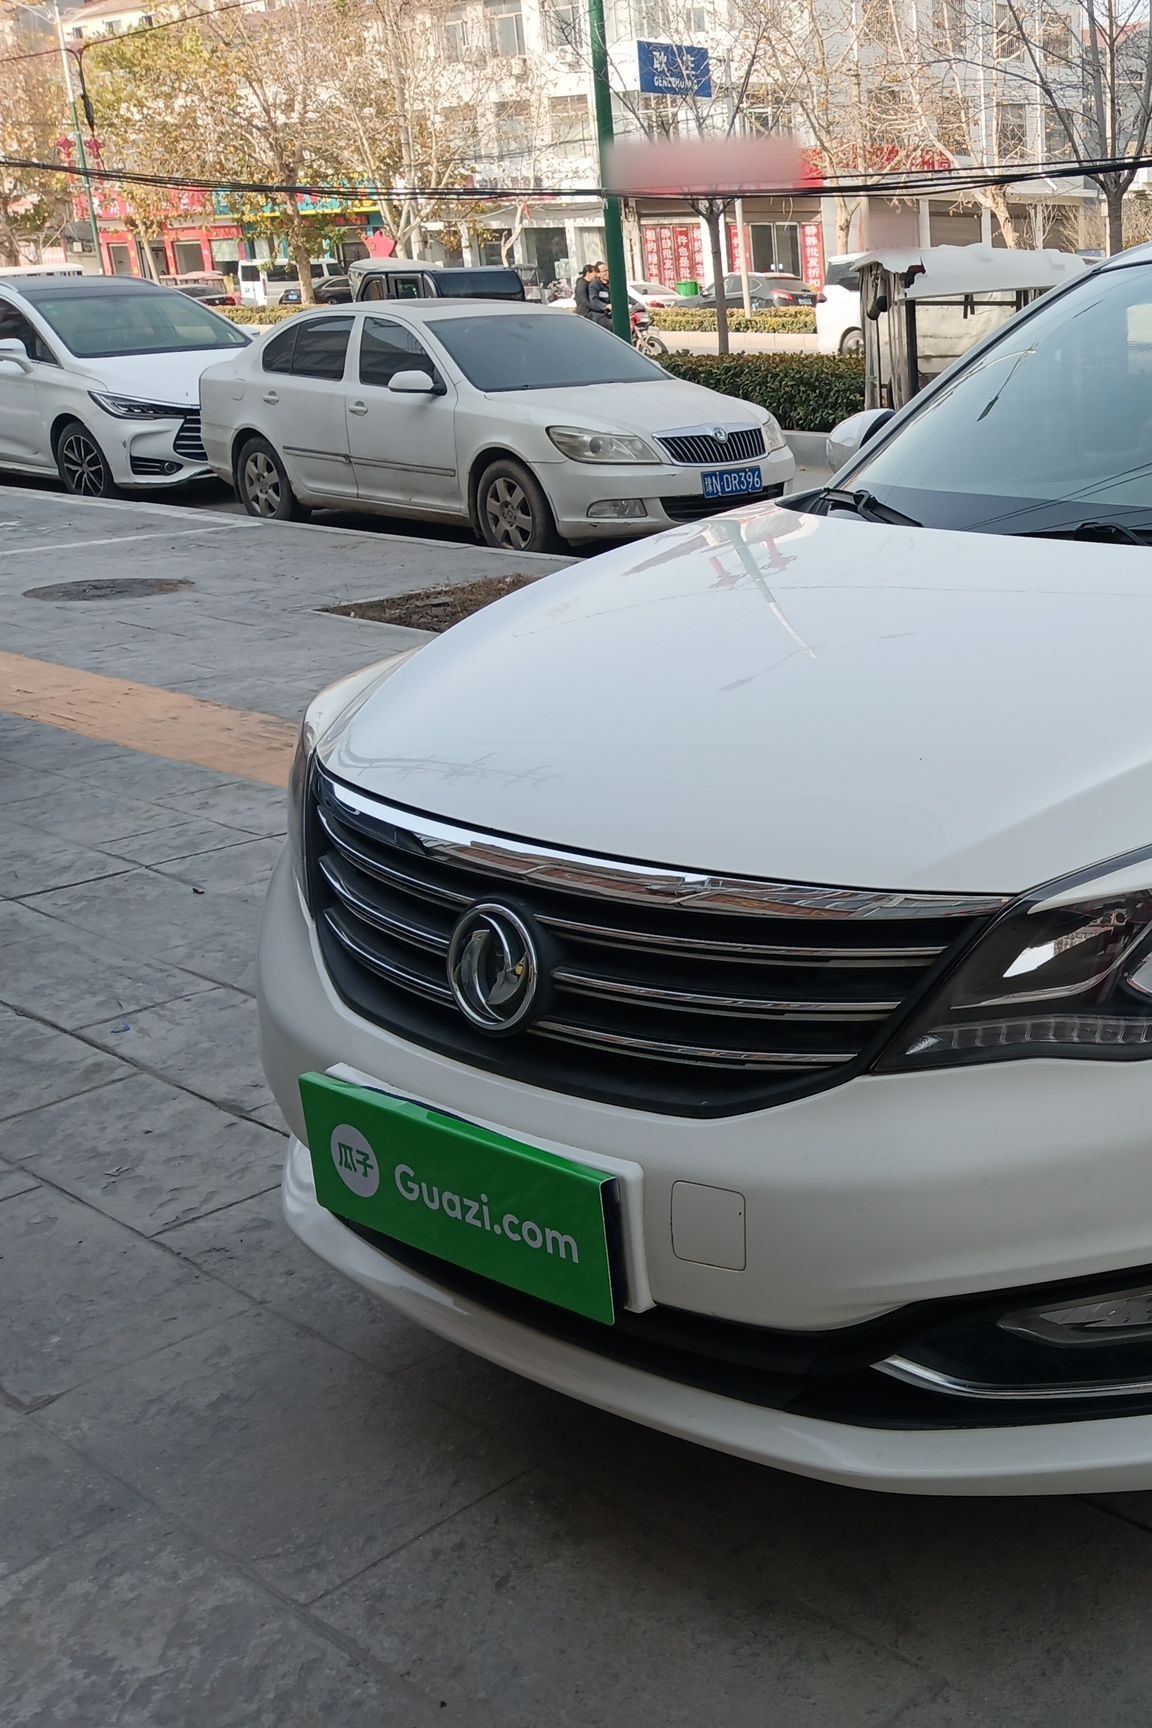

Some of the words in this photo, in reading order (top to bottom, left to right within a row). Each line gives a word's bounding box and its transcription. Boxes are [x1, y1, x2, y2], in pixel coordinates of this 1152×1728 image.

[675, 227, 691, 281] 一件也是批
[336, 1141, 374, 1178] 瓜子
[394, 1163, 580, 1265] Guazi.com
